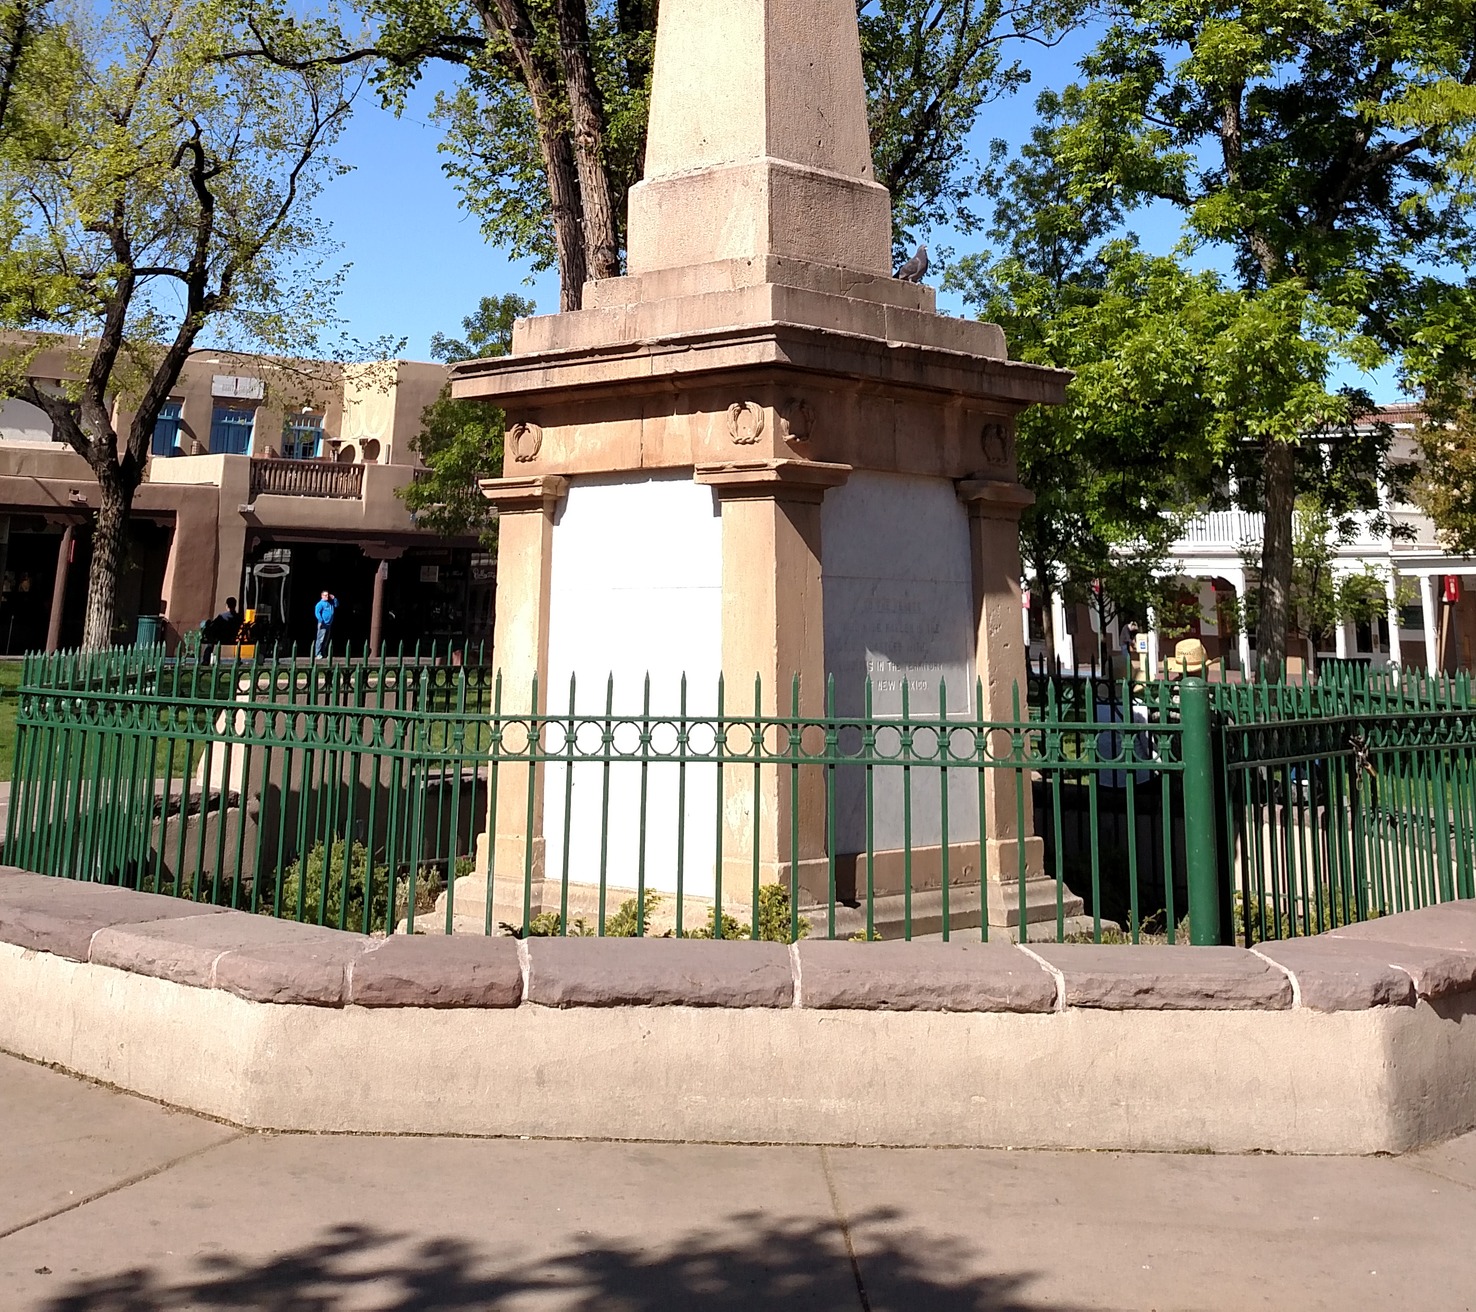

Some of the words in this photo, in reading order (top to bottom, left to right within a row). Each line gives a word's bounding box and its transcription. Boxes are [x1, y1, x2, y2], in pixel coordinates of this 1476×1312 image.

[877, 661, 885, 672] IN
[887, 661, 901, 672] THE
[877, 680, 896, 691] NEW
